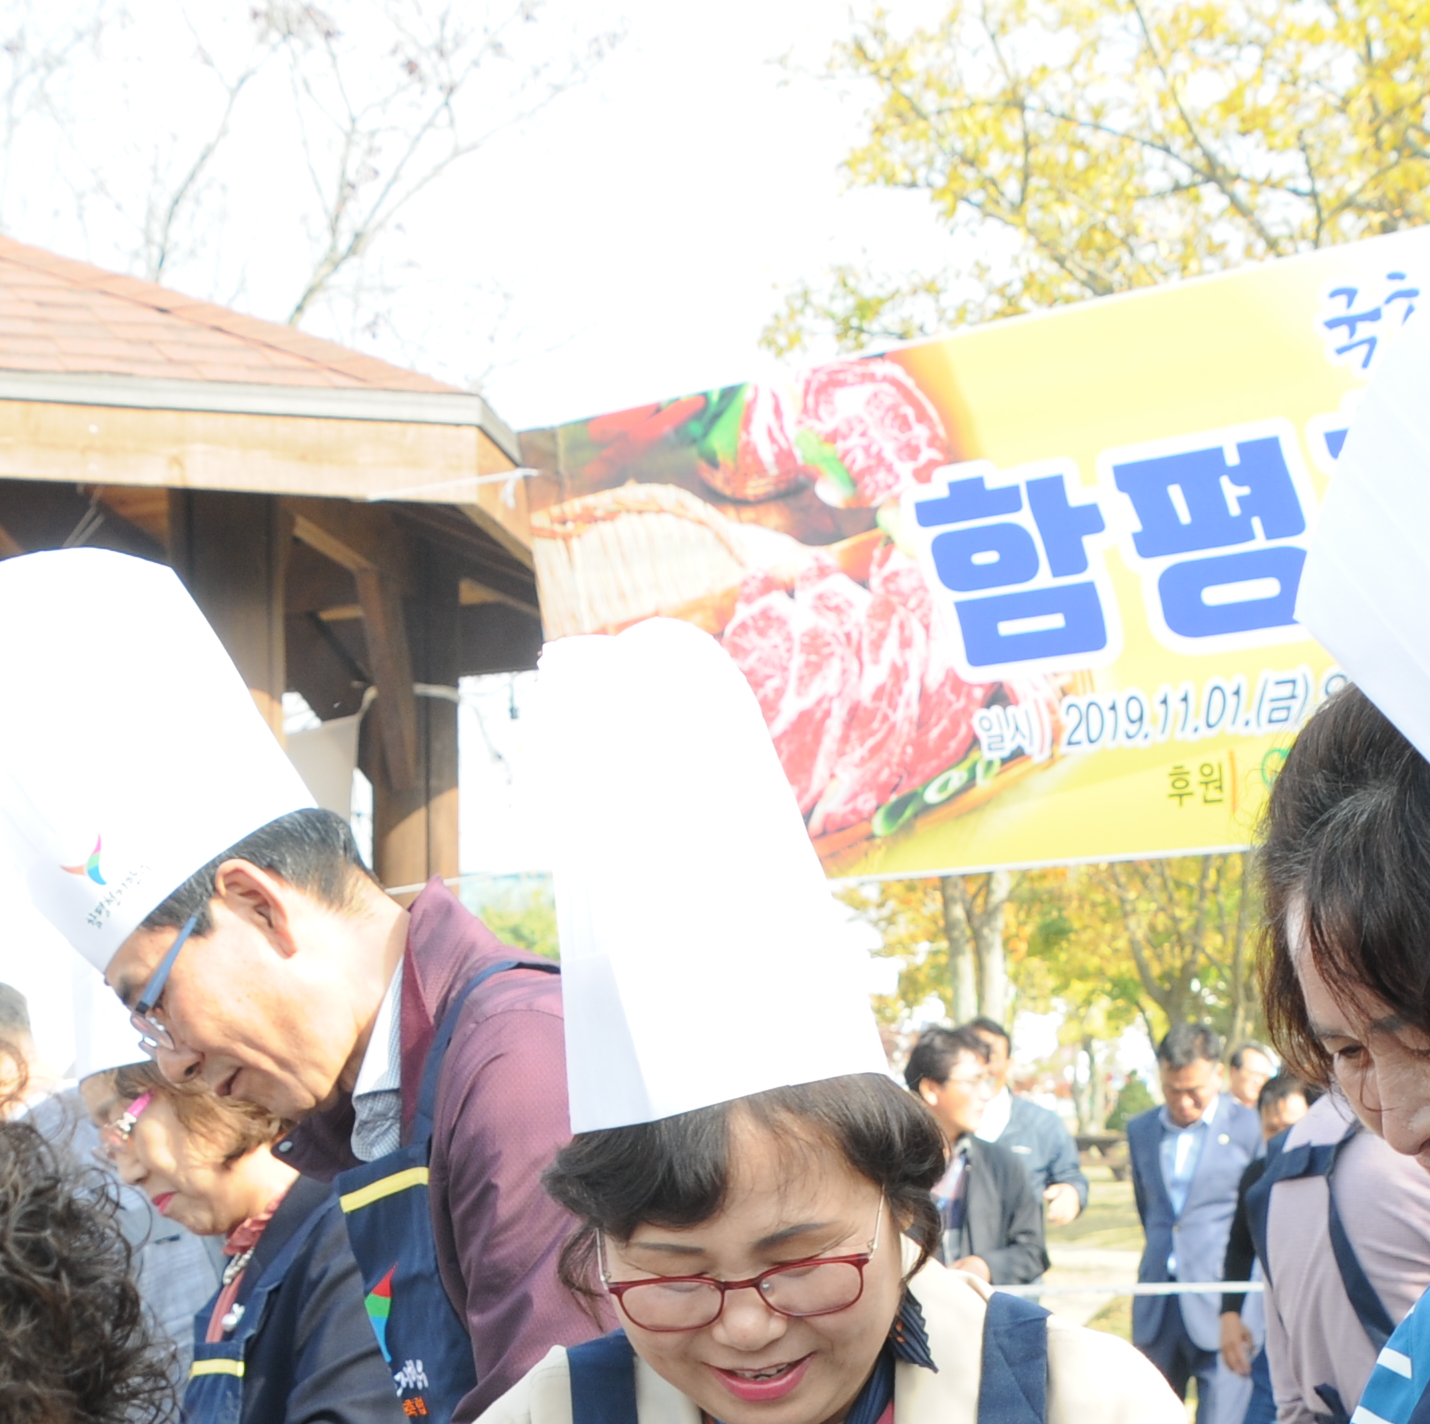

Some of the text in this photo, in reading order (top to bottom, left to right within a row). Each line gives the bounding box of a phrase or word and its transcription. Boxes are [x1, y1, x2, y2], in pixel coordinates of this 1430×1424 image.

[914, 428, 1350, 668] 함평
[978, 701, 1034, 754] 일시
[1065, 670, 1310, 747] 2019.11.01.(금)
[1168, 761, 1224, 807] 후원
